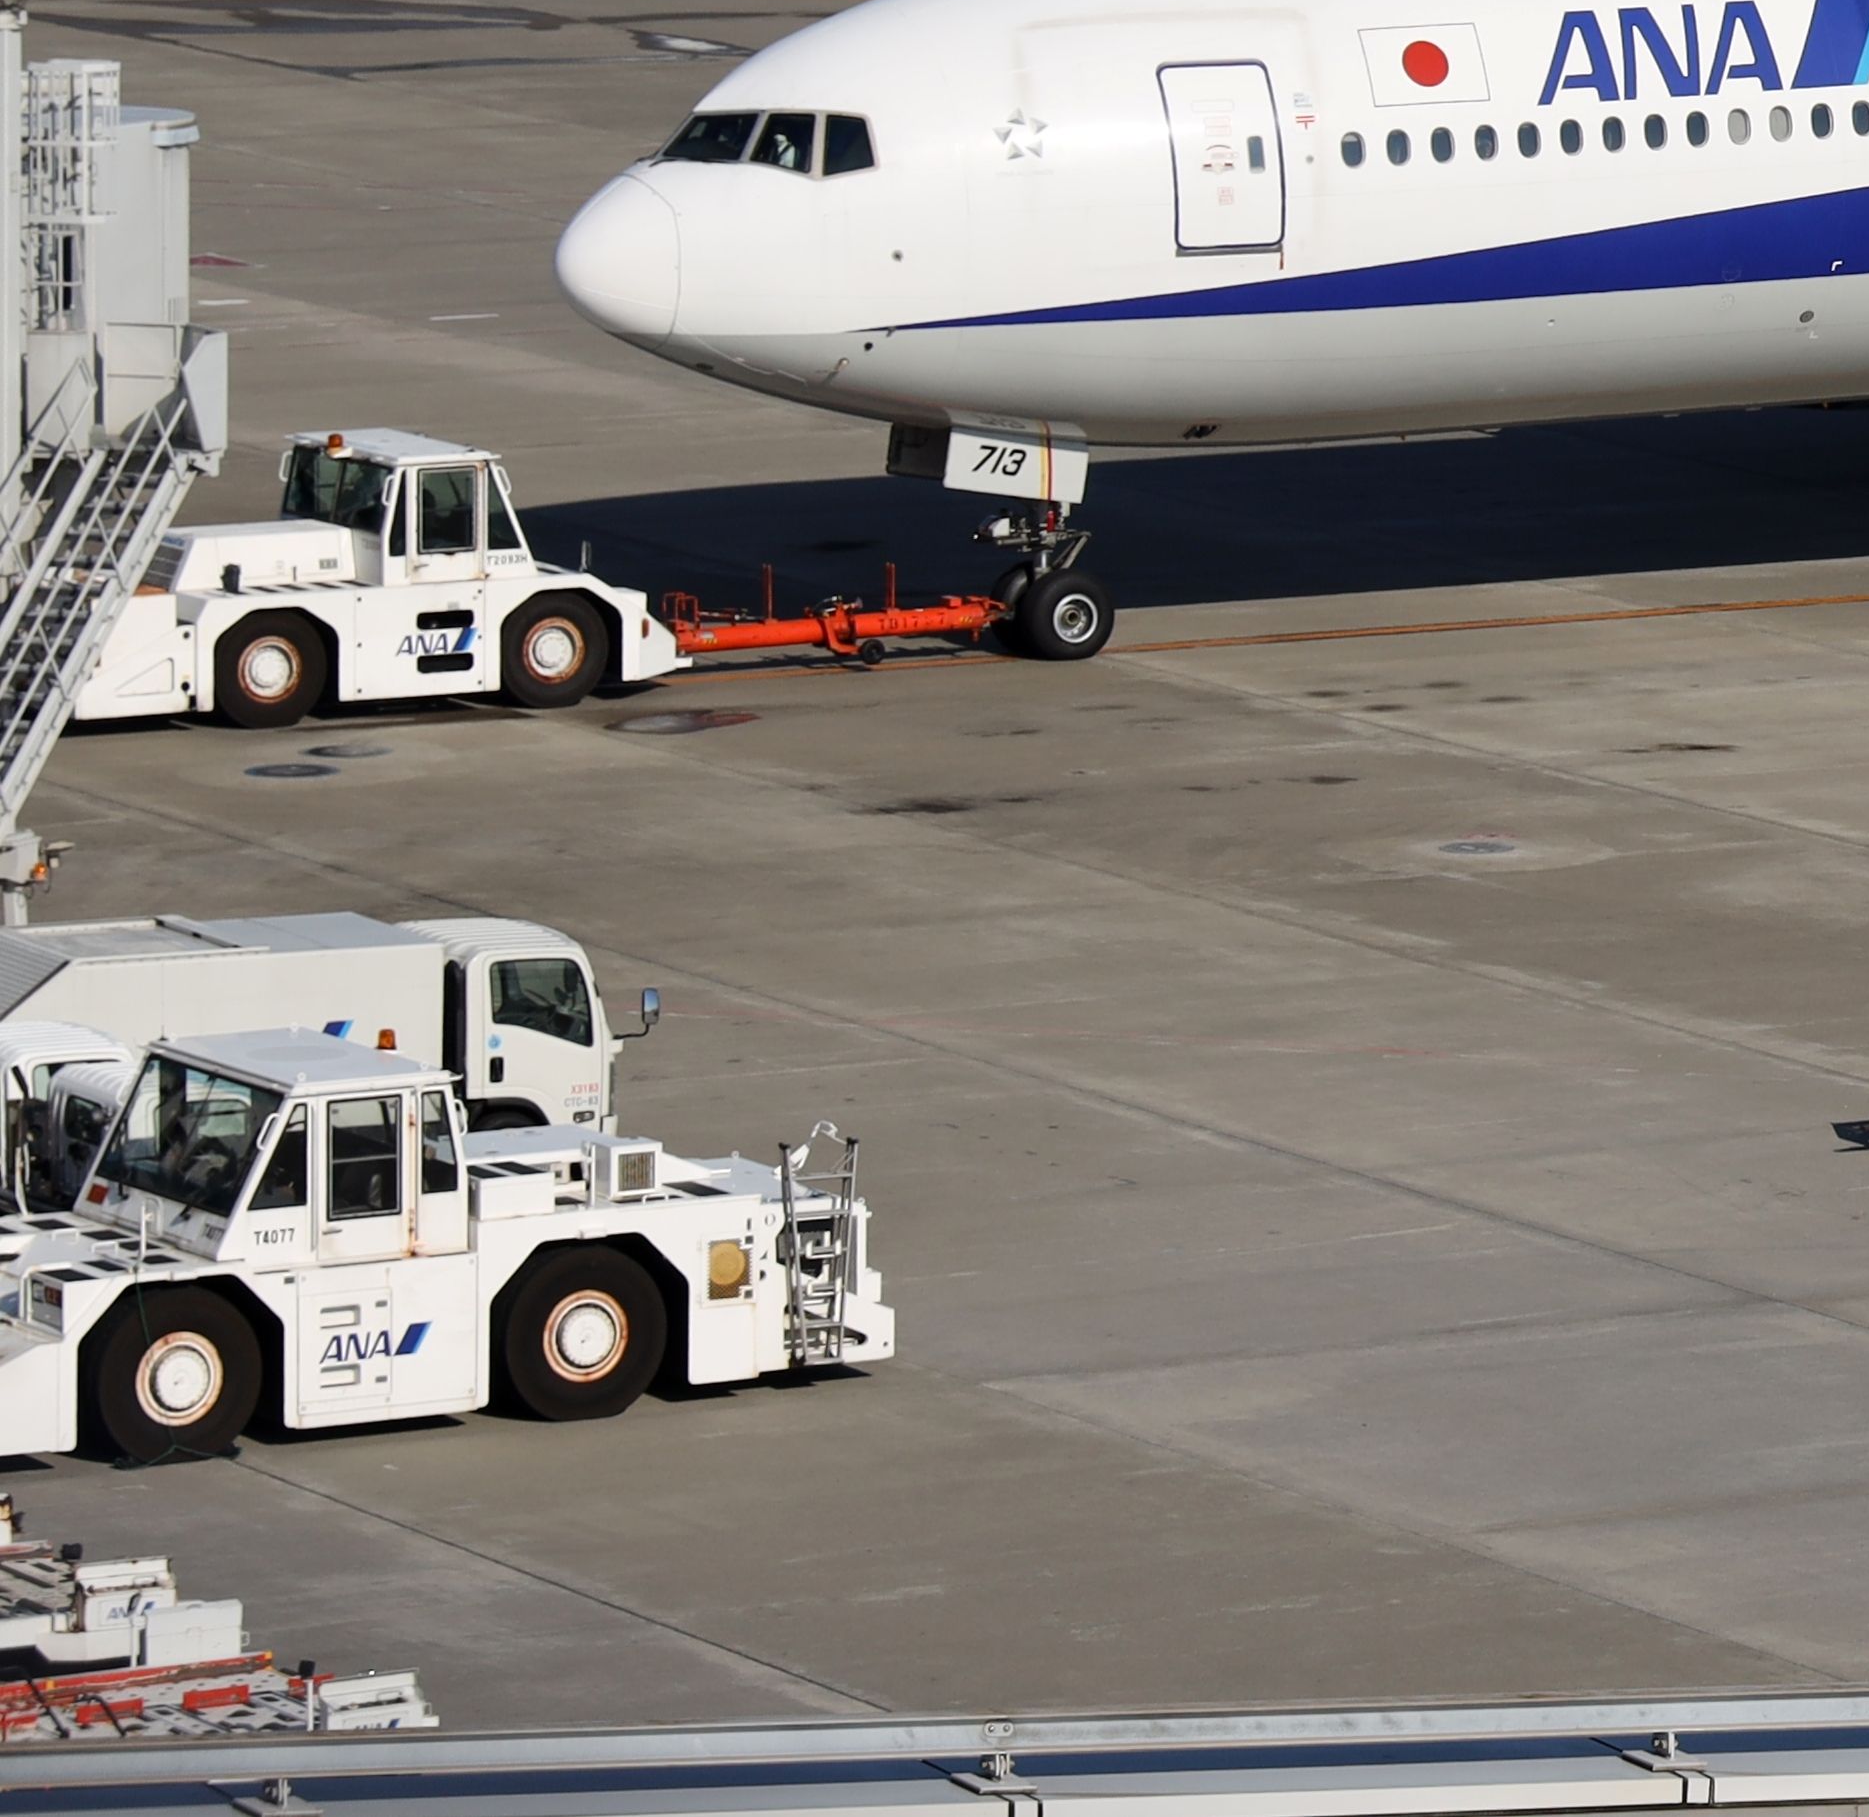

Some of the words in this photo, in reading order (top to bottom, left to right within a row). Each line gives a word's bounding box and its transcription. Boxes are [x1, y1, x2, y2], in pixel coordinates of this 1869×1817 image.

[1537, 0, 1784, 106] ANA
[972, 445, 1026, 477] 713
[396, 633, 449, 659] ANA
[254, 1228, 295, 1246] T4077
[320, 1330, 392, 1364] ANA
